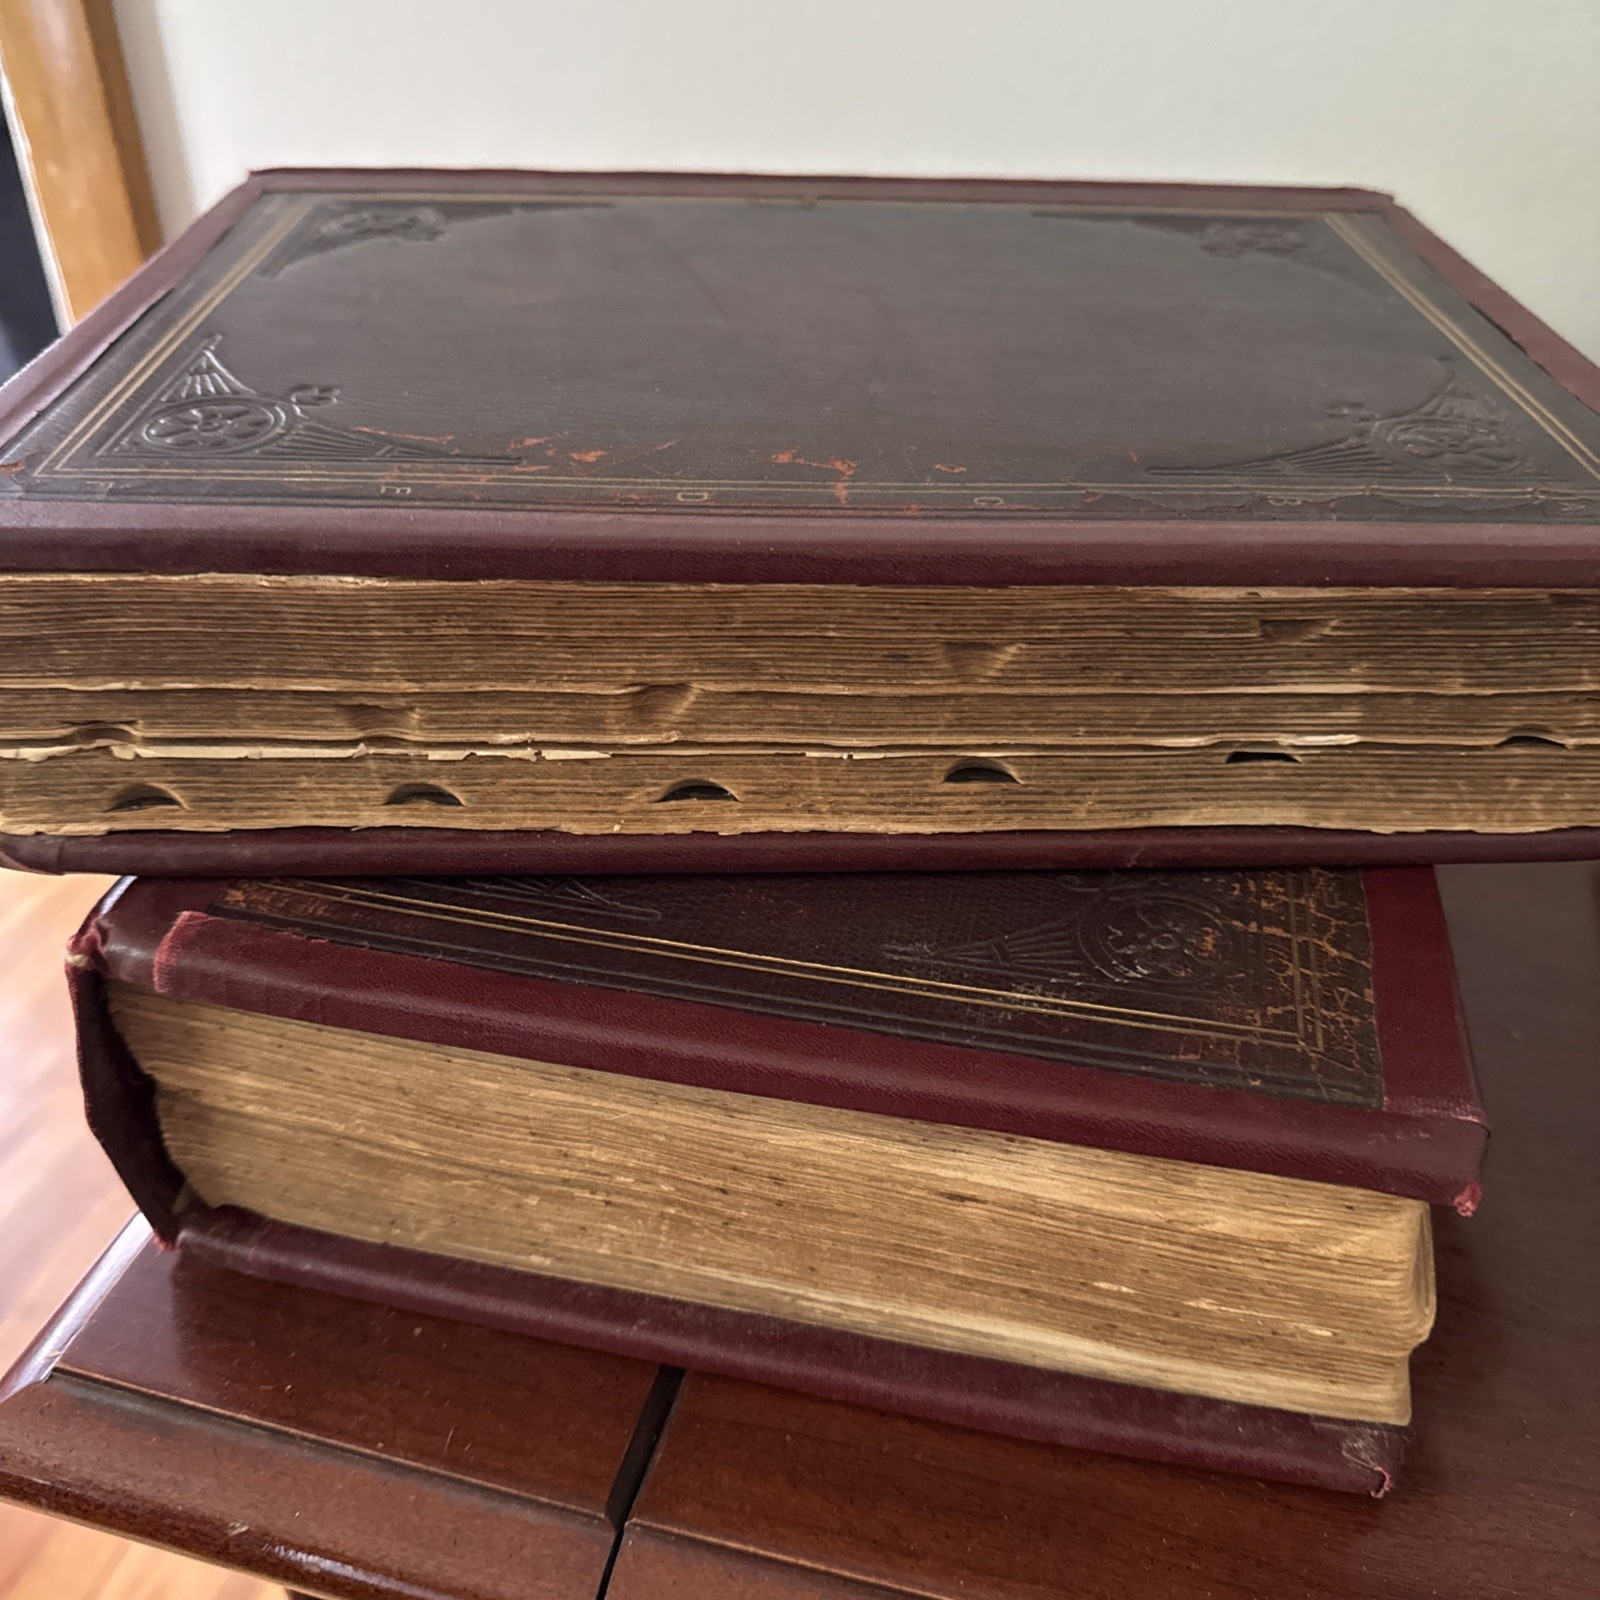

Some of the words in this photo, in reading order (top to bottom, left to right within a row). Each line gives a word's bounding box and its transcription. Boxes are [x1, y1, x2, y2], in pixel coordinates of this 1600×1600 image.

[380, 485, 411, 495] E
[677, 492, 708, 502] D
[973, 496, 1004, 507] C
